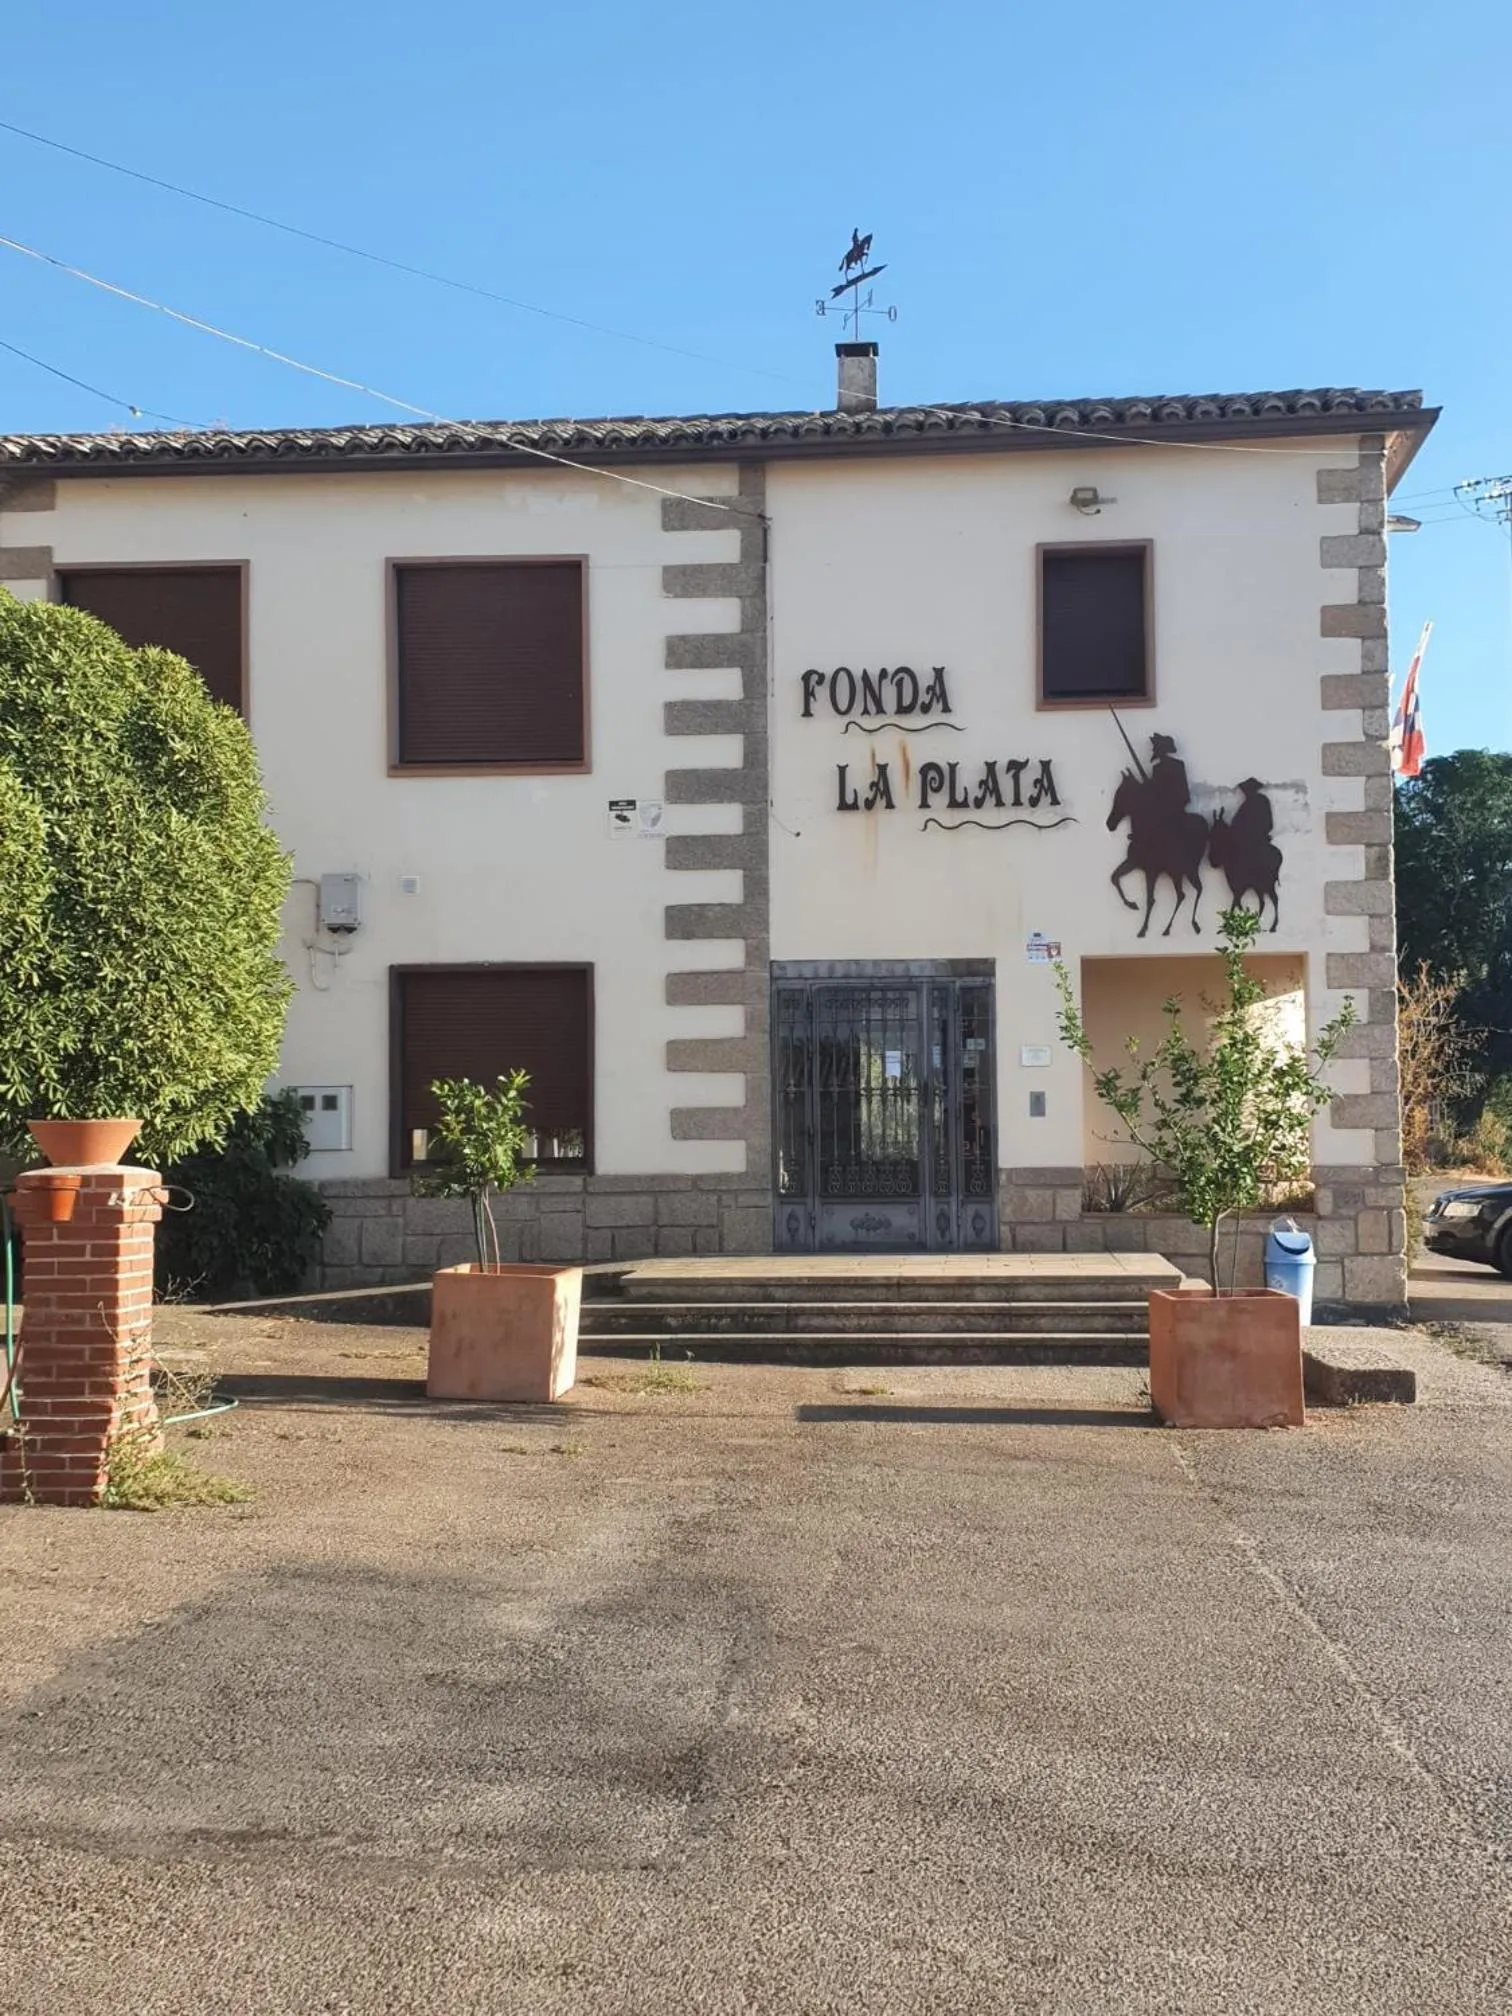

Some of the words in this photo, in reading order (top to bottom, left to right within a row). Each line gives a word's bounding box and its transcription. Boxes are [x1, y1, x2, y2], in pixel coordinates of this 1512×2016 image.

[800, 666, 952, 717] FONDA
[836, 763, 896, 811] LA
[918, 758, 1061, 809] PLATA
